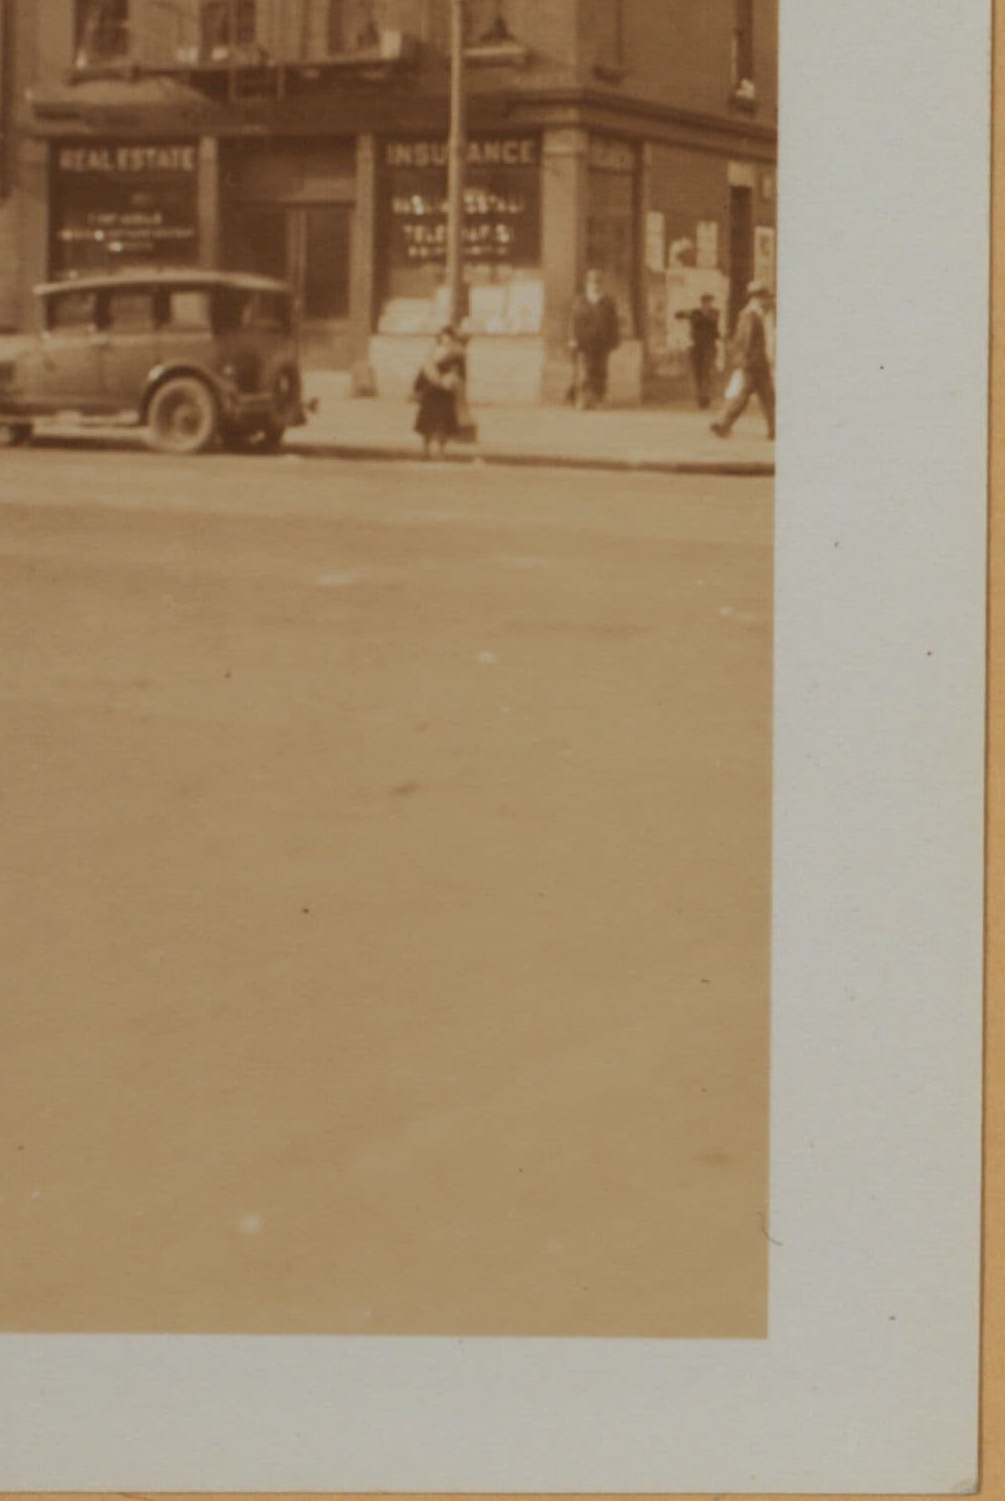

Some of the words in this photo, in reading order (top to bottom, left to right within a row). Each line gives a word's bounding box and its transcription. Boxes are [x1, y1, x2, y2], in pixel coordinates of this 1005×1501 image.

[60, 148, 114, 171] REAL
[117, 146, 195, 171] ESTATE
[386, 140, 534, 166] INSUANCE
